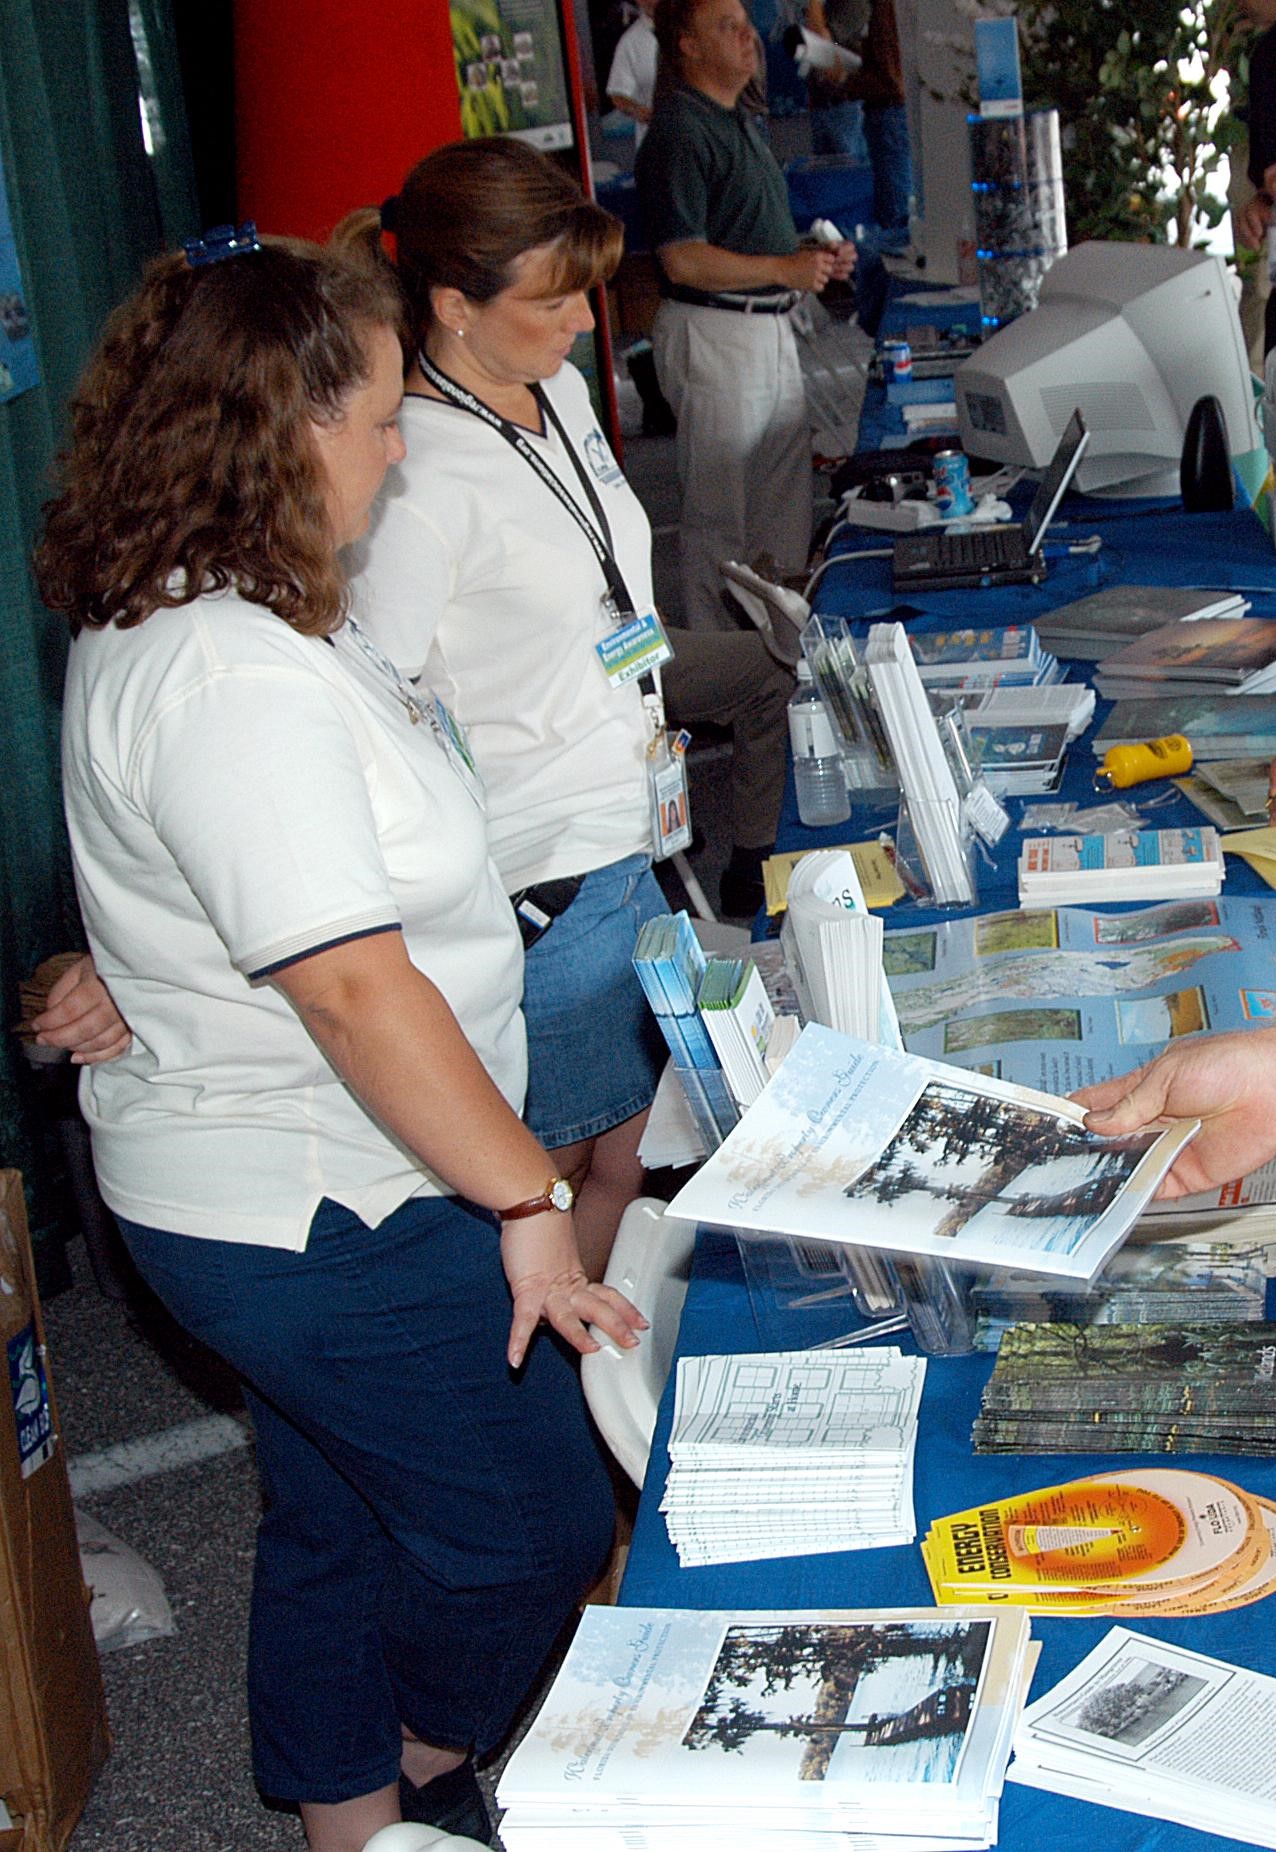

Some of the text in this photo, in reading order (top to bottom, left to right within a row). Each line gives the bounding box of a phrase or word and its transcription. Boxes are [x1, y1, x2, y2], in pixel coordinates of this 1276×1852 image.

[620, 654, 659, 681] Exhibitor
[834, 1053, 864, 1087] Guide
[1206, 1504, 1222, 1534] FLOIDA
[951, 1524, 985, 1573] ENERGY
[979, 1509, 1011, 1579] CONSERVATION
[628, 1623, 654, 1651] Guide
